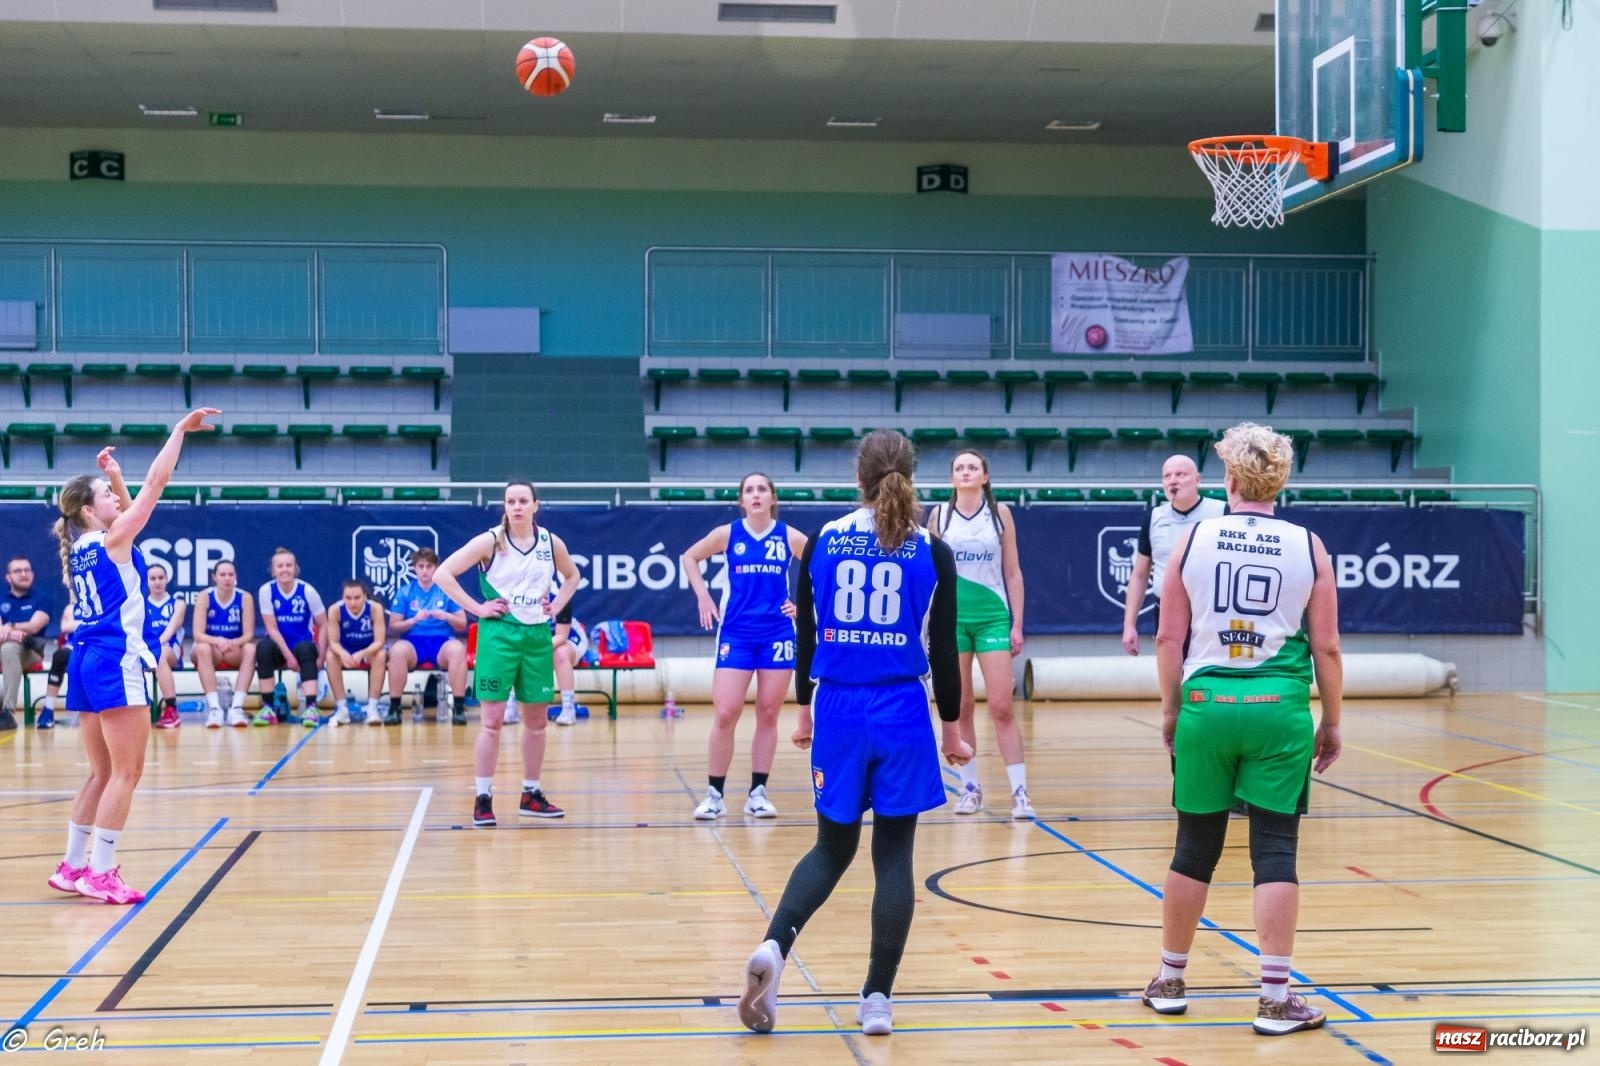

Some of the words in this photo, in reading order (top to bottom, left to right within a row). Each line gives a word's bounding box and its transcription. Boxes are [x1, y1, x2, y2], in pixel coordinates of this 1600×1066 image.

[73, 159, 89, 176] C
[100, 160, 119, 177] C
[922, 174, 941, 189] D
[950, 174, 965, 189] D
[1069, 260, 1175, 284] MIESZKO
[828, 535, 868, 547] MKS
[1219, 529, 1247, 541] RKK
[1256, 534, 1281, 544] AZS
[764, 540, 787, 561] 26
[956, 550, 994, 561] Clavis
[742, 564, 782, 574] BETARD
[834, 559, 902, 625] 88
[1214, 561, 1282, 616] 10
[291, 598, 305, 614] 22
[838, 629, 907, 646] BETARD
[772, 640, 794, 662] 26
